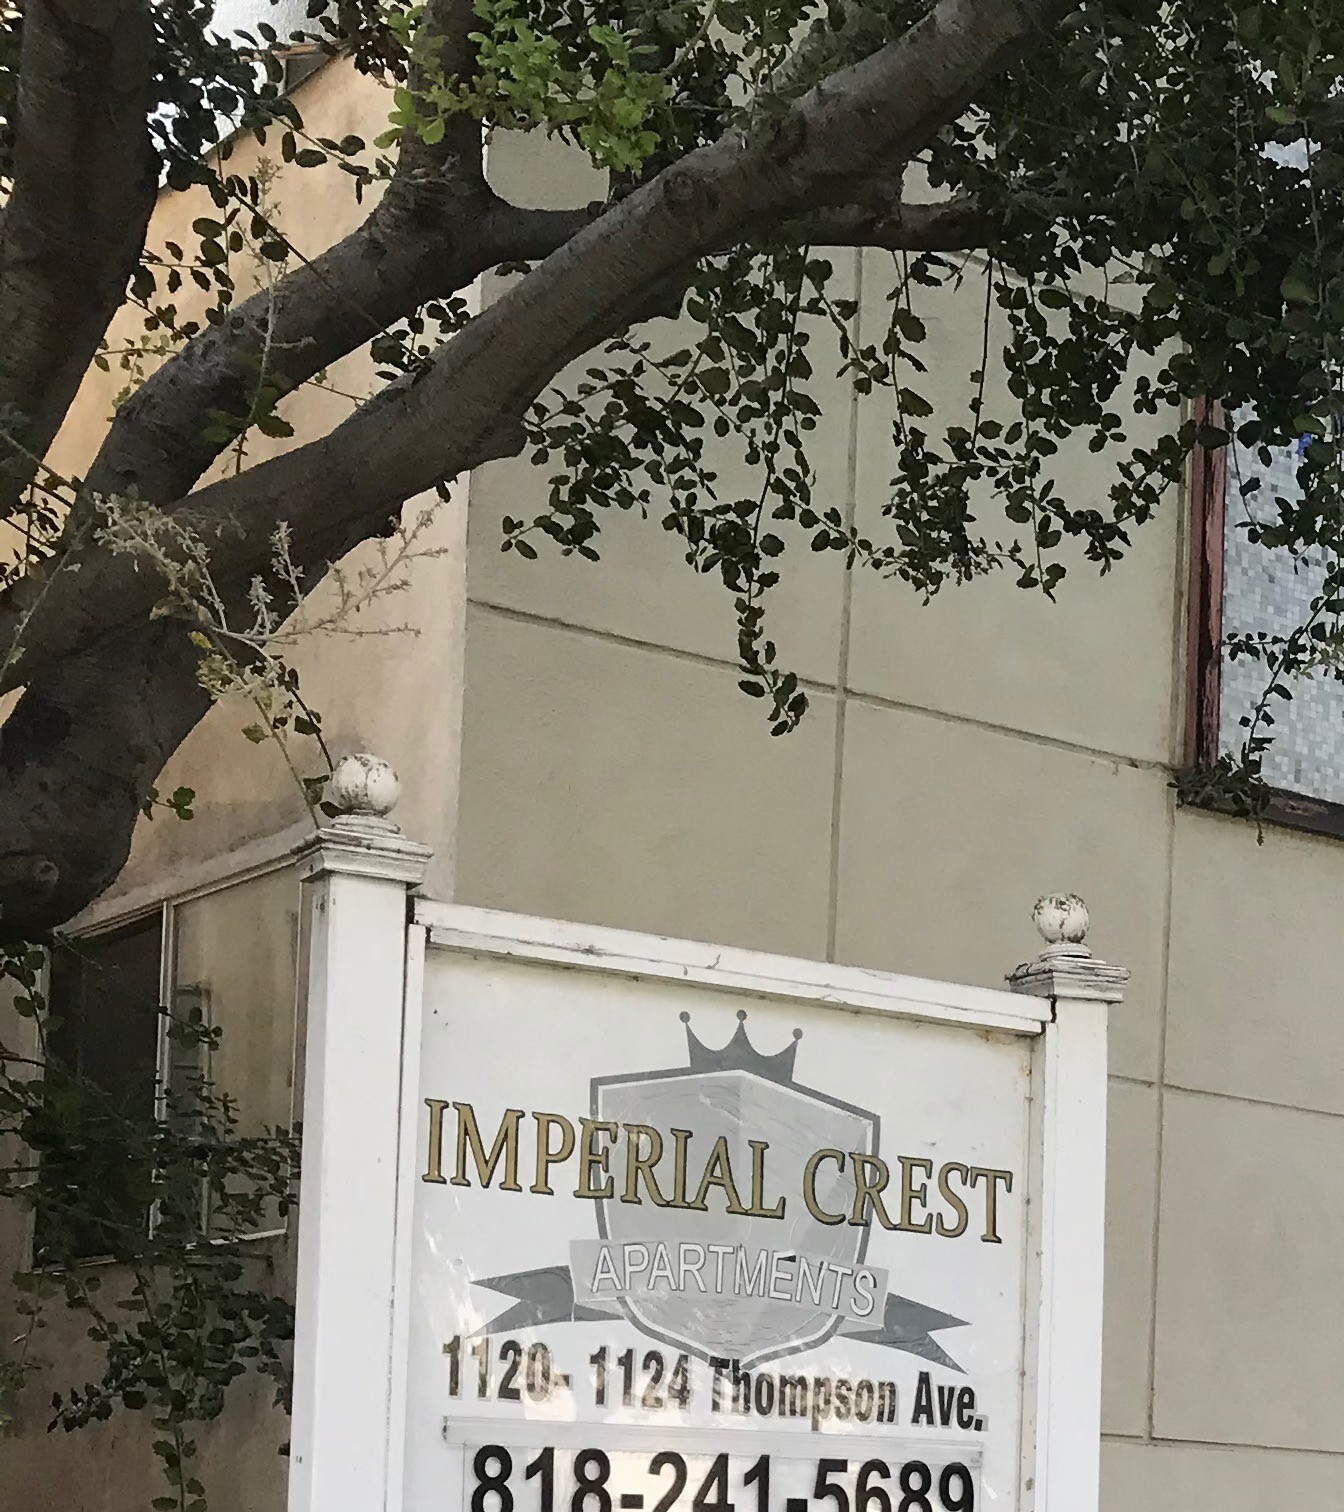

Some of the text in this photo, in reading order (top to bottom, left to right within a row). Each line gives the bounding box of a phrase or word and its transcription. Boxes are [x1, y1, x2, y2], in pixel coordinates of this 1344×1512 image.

[422, 1098, 1013, 1244] IMPERIAL CREST
[591, 1242, 878, 1317] APARTMENTS
[442, 1334, 984, 1432] 1120- 1124 Thompson Ave.
